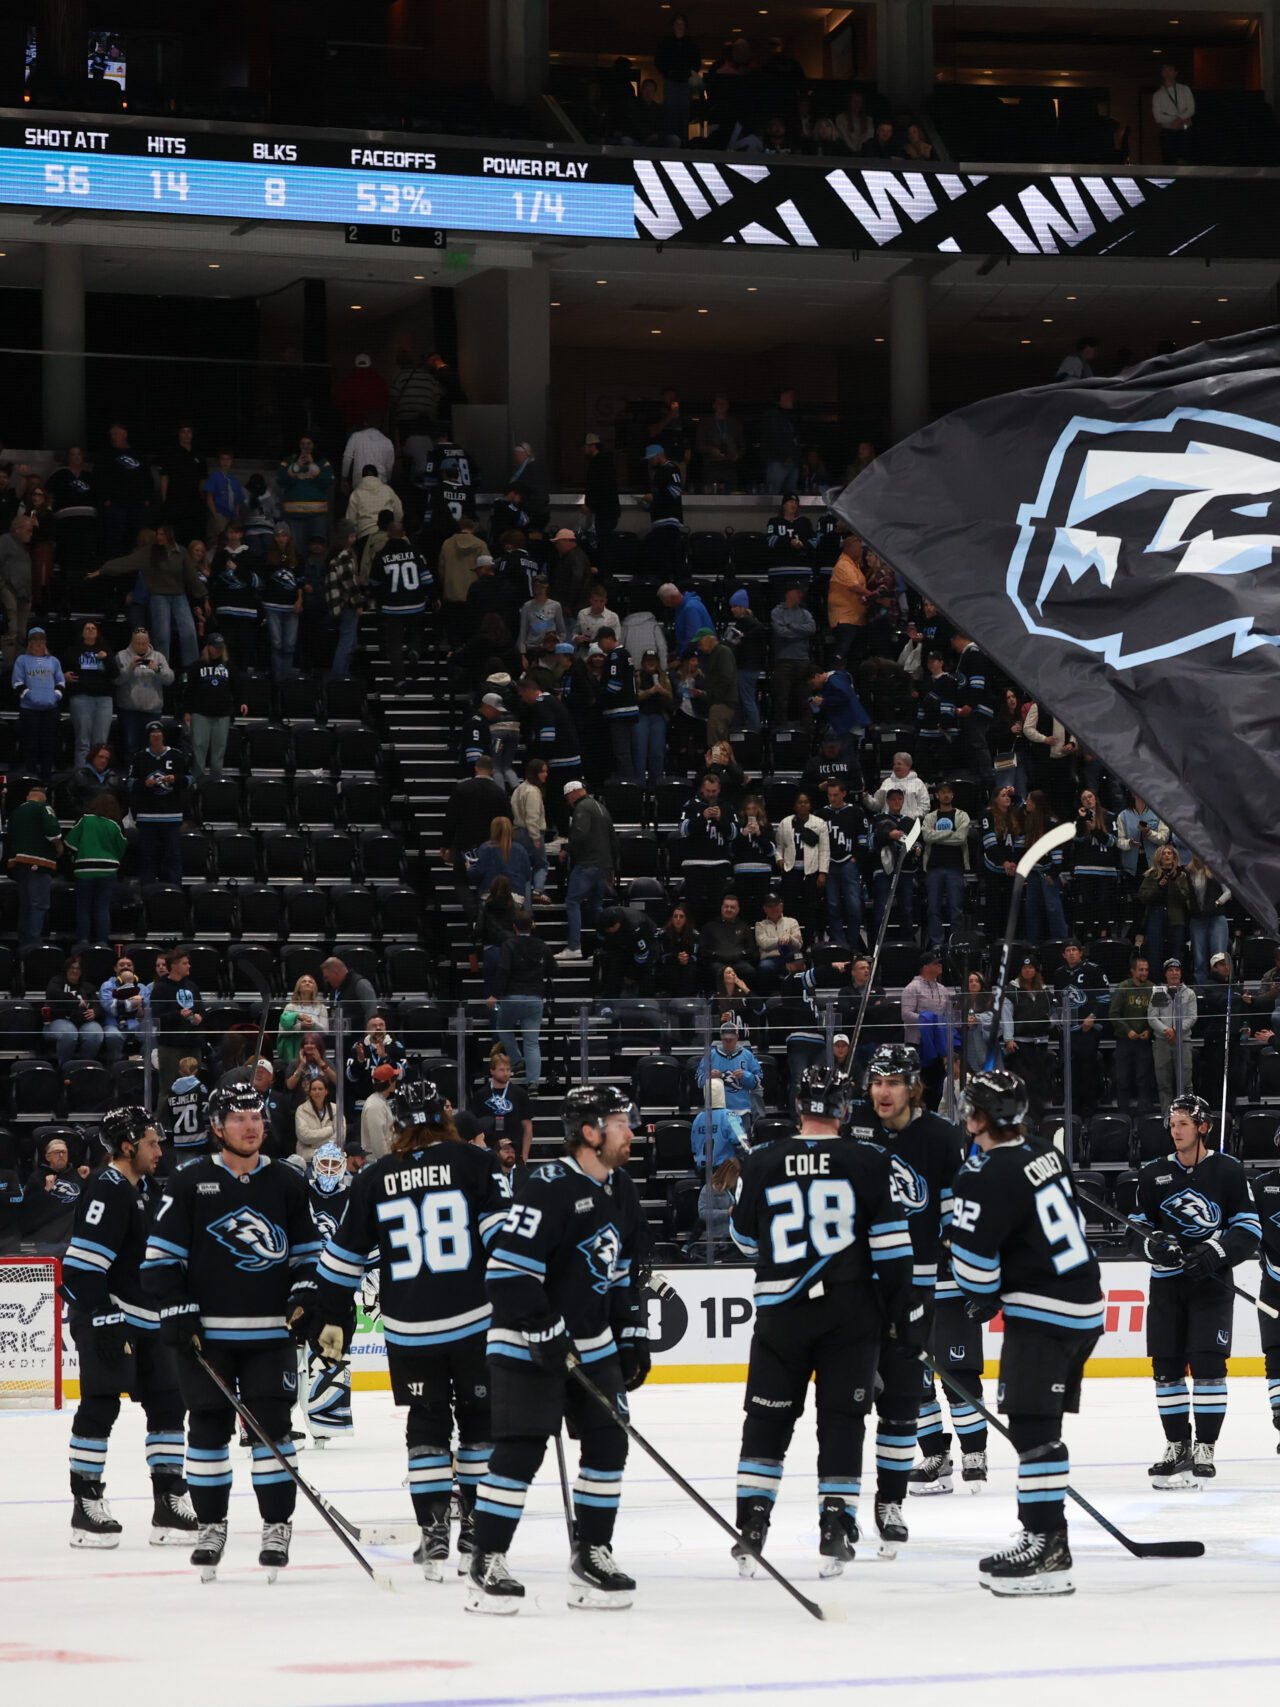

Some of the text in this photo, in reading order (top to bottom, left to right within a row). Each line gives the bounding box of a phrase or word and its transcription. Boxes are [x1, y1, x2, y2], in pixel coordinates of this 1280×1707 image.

[25, 128, 109, 149] SHOT ATT
[147, 136, 186, 154] HITS
[253, 143, 297, 161] BLKS
[351, 149, 436, 170] FACEOFFS
[483, 157, 589, 178] POWER PLAY
[44, 164, 90, 195] 56
[150, 170, 190, 201] 14
[265, 177, 286, 207] 8
[356, 183, 432, 216] 53%
[512, 191, 565, 223] 1/4
[349, 226, 443, 245] 2 C 3
[382, 551, 416, 563] VEJMELKA
[383, 561, 420, 593] 70
[200, 666, 229, 679] UTAH
[165, 760, 173, 770] C
[172, 1104, 199, 1133] 70
[413, 1112, 426, 1124] 38
[810, 1102, 825, 1113] 28
[785, 1153, 831, 1176] COLE
[384, 1164, 452, 1196] O'BRIEN
[85, 1199, 105, 1226] 8
[154, 1195, 174, 1222] 7
[502, 1203, 543, 1240] 53
[764, 1178, 857, 1264] 28
[950, 1198, 982, 1233] 92
[376, 1189, 473, 1282] 38
[752, 1395, 793, 1409] BAUER
